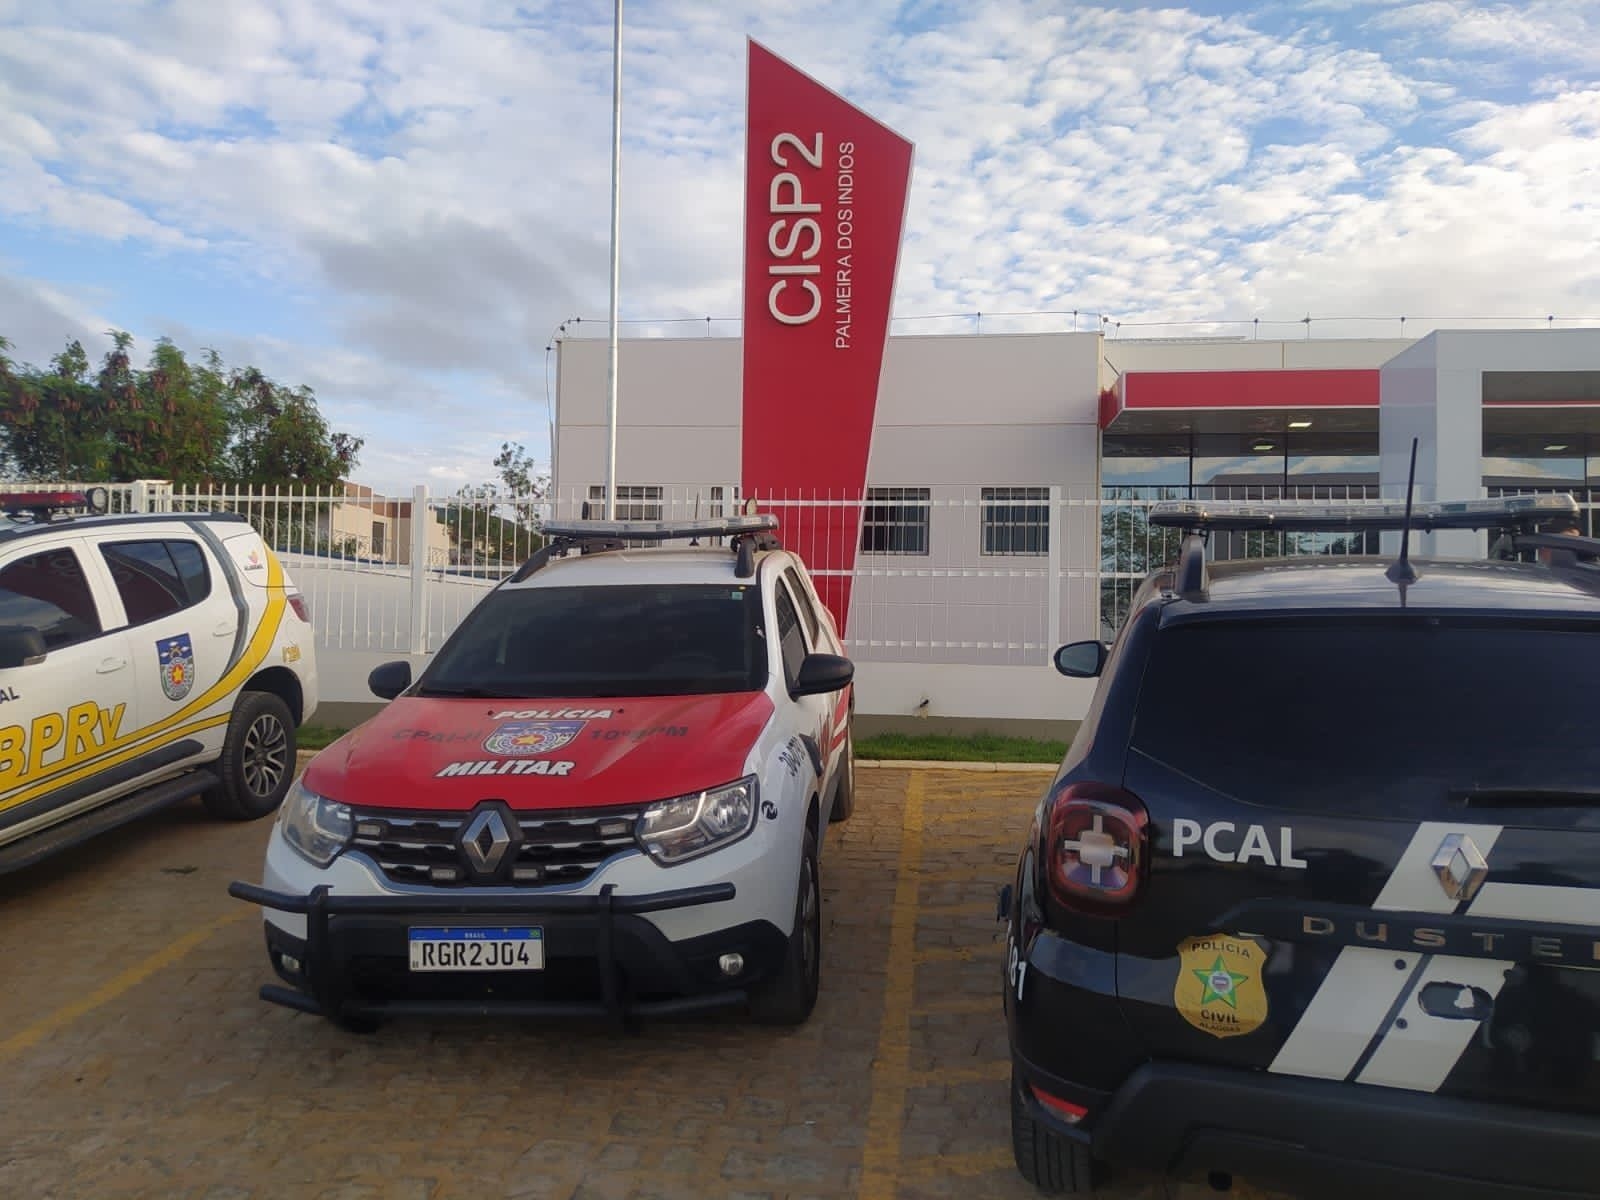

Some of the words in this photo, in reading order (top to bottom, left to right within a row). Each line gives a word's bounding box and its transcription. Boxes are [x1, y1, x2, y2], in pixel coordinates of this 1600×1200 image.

[838, 141, 855, 204] INDIOS
[768, 132, 823, 325] CISP2
[837, 209, 854, 250] DOS
[835, 254, 852, 349] PALMEIRA
[433, 759, 576, 777] MILITAR
[1172, 818, 1308, 869] PCAL
[422, 942, 530, 966] RGR2J04
[1201, 1009, 1240, 1024] CIVIL
